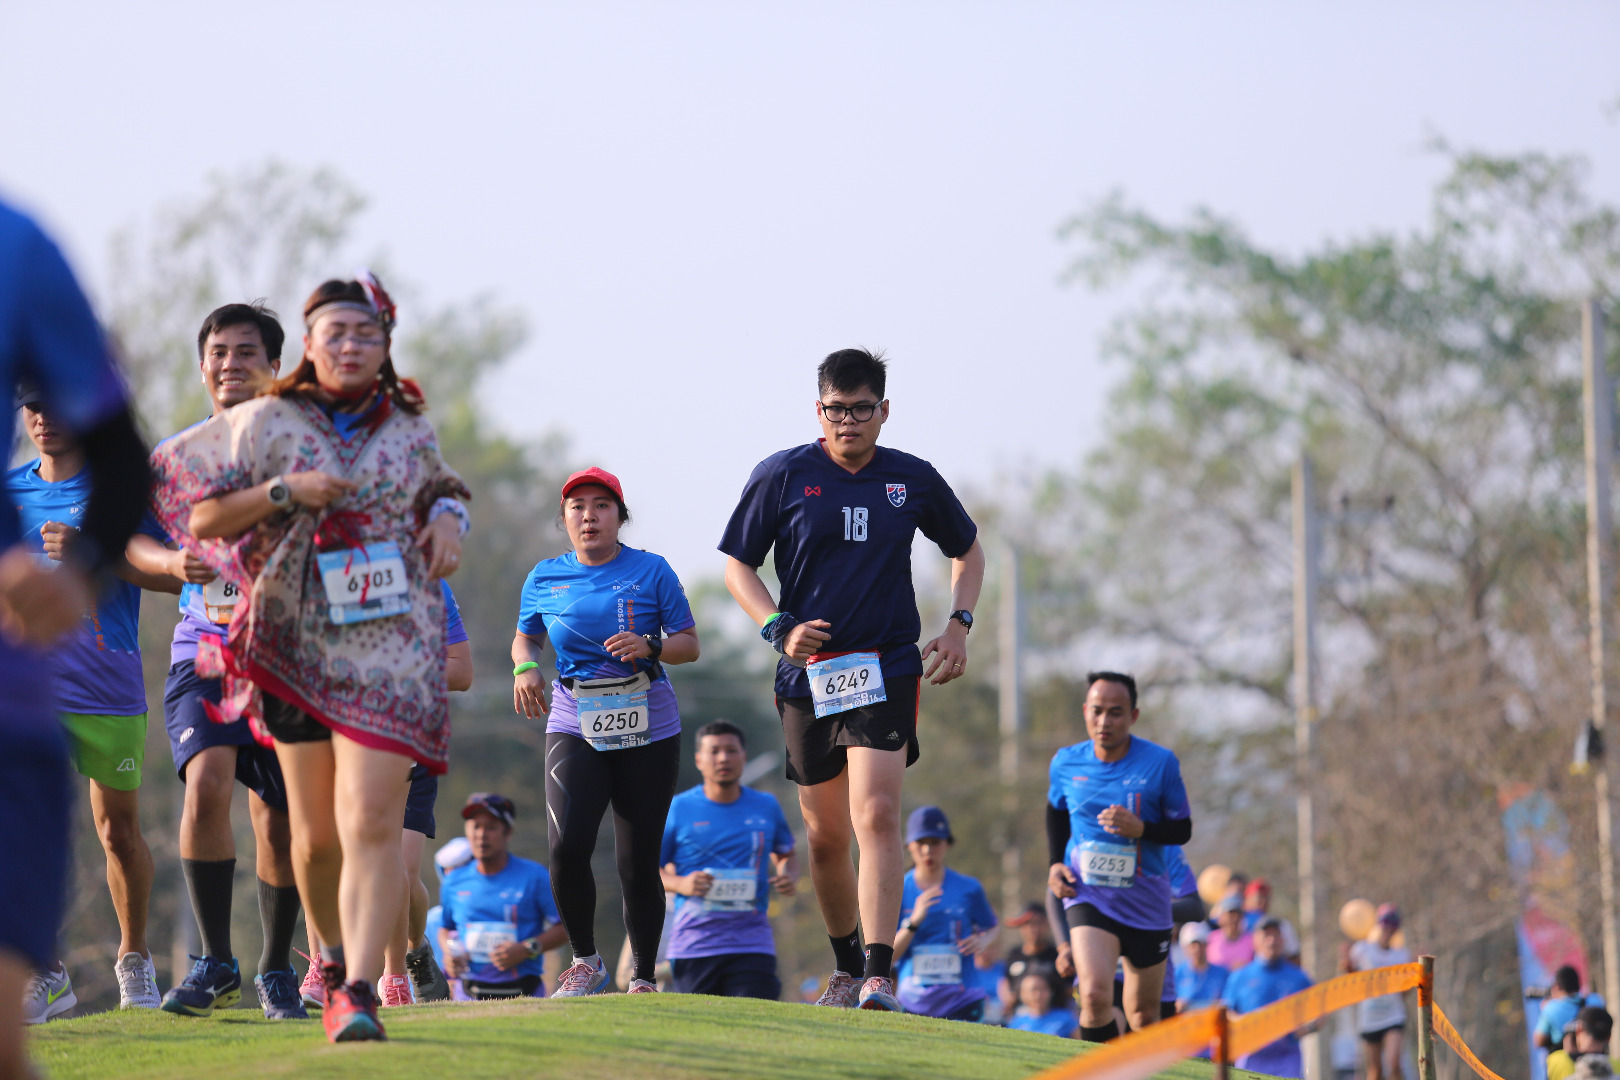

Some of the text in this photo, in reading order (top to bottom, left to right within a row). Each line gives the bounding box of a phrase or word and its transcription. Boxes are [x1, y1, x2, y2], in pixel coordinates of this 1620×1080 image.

[842, 506, 869, 541] 18
[617, 598, 625, 623] CROSS
[627, 599, 636, 631] SINGHA
[825, 668, 870, 695] 6249
[592, 711, 639, 732] 6250
[1089, 856, 1127, 873] 6253
